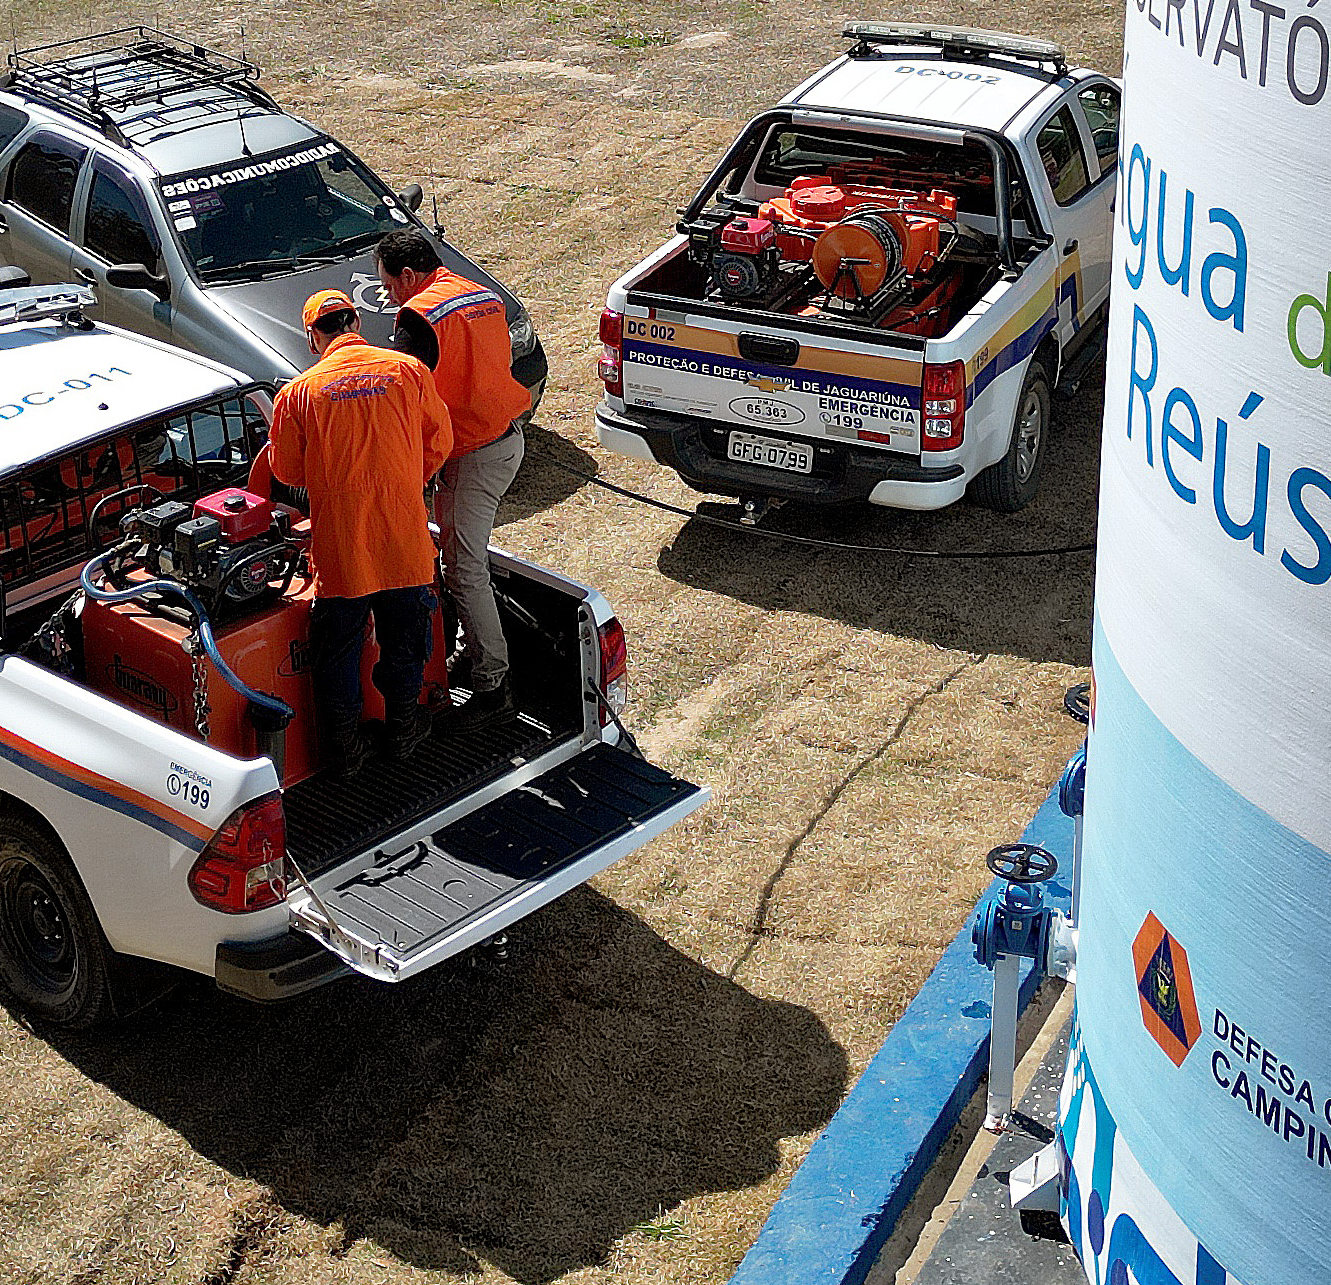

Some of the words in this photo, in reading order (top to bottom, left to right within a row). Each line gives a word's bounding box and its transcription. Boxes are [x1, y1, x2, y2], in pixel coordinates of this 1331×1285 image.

[1119, 51, 1248, 333] gua
[628, 320, 647, 336] DC
[650, 324, 676, 342] 002
[629, 350, 699, 371] PROTEÇÃO
[702, 364, 710, 374] E
[713, 366, 761, 381] DEFE
[802, 381, 820, 393] DE
[823, 384, 911, 407] JAGUARIÚNA
[819, 398, 916, 425] EMERGÊNCIA
[832, 413, 863, 429] 199
[182, 780, 210, 810] 199
[1212, 1007, 1316, 1115] DEFESA
